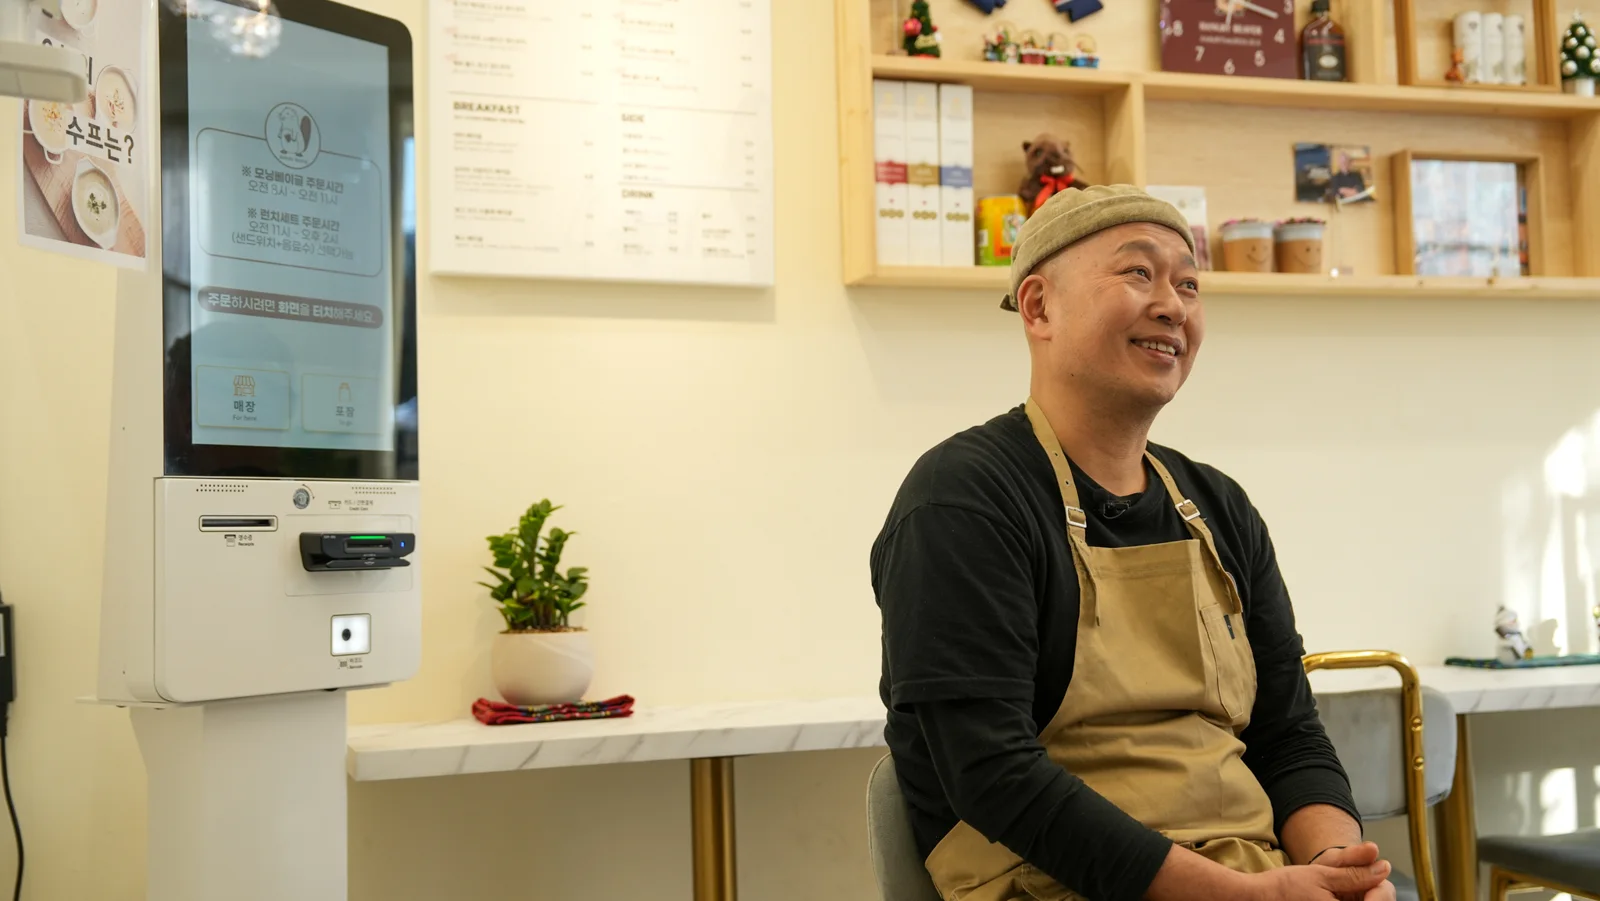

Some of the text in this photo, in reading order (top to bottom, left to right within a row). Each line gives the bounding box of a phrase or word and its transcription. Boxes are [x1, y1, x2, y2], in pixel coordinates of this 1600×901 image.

[1173, 20, 1183, 37] 8
[1274, 28, 1285, 44] 4
[1195, 46, 1205, 62] 7
[1254, 50, 1266, 67] 5
[1224, 58, 1235, 75] 6
[453, 101, 520, 115] BREAKFAST
[66, 116, 134, 164] 수프는?
[254, 167, 304, 187] 모닝베이글
[306, 176, 344, 194] 주문시간
[248, 179, 269, 194] 오전
[298, 188, 318, 203] 오전
[249, 220, 269, 234] 오전
[272, 223, 291, 237] 11시
[260, 208, 299, 226] 런치세트
[302, 215, 340, 232] 주문시간
[208, 292, 275, 313] 주문하시려면
[278, 301, 310, 317] 화면을
[233, 401, 256, 413] 매장
